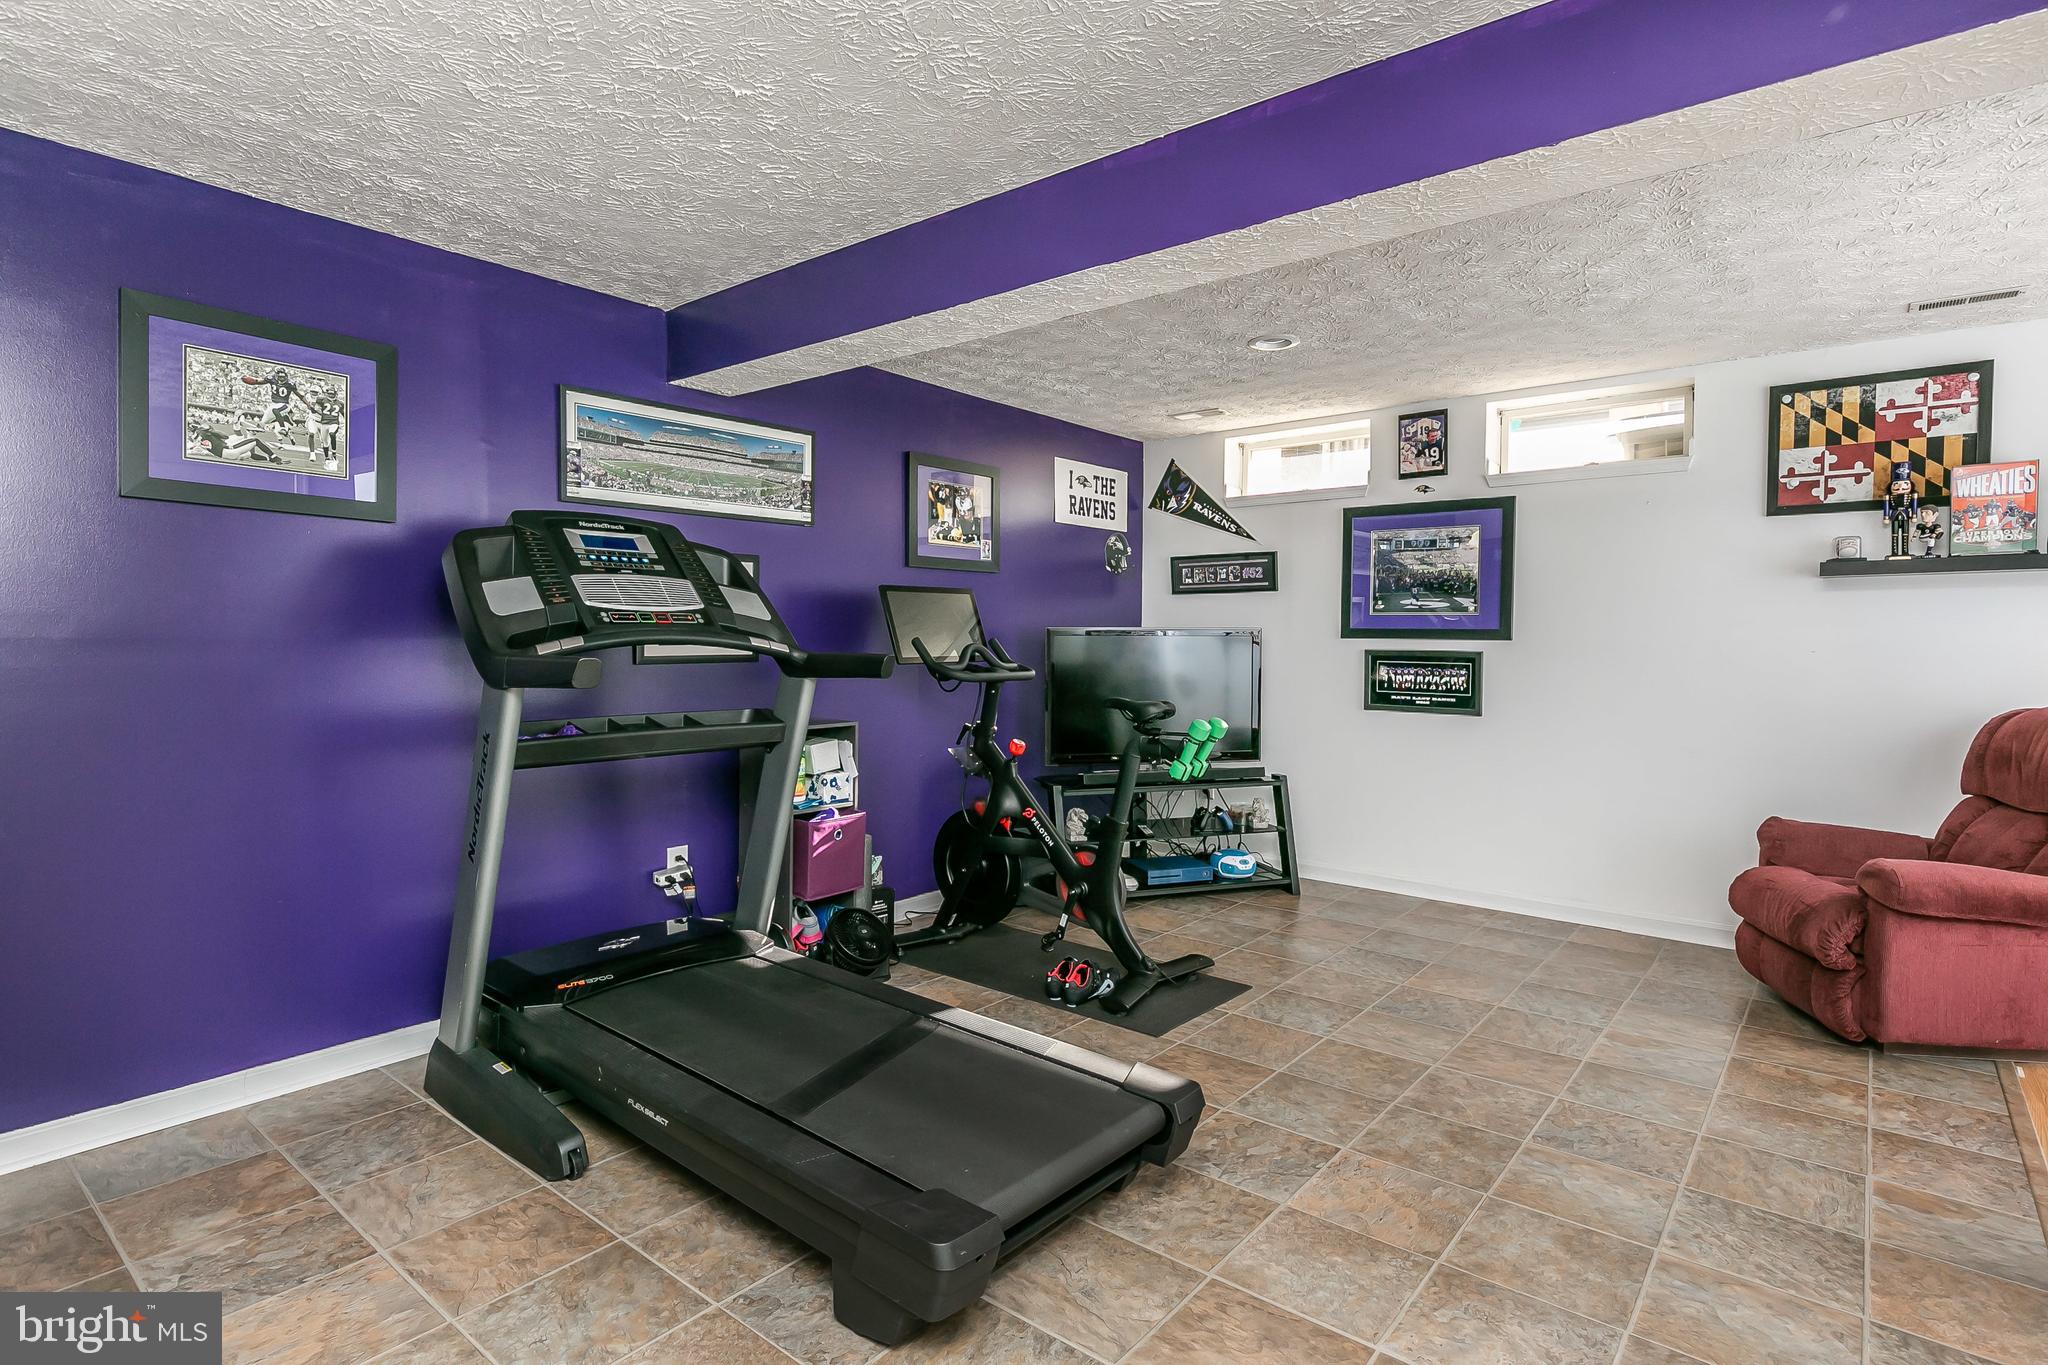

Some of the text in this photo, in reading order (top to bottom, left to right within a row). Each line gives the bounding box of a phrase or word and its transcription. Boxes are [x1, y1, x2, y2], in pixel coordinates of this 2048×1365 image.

[323, 403, 340, 416] 22
[1424, 447, 1440, 461] 19
[1068, 470, 1116, 497] I THE
[1957, 465, 2036, 498] WHEATIES
[1069, 494, 1116, 521] RAVENS
[1193, 501, 1238, 532] RAVENS
[578, 521, 625, 531] NordicTrack
[468, 731, 490, 864] NordicTrack
[1031, 817, 1054, 847] PELOTON
